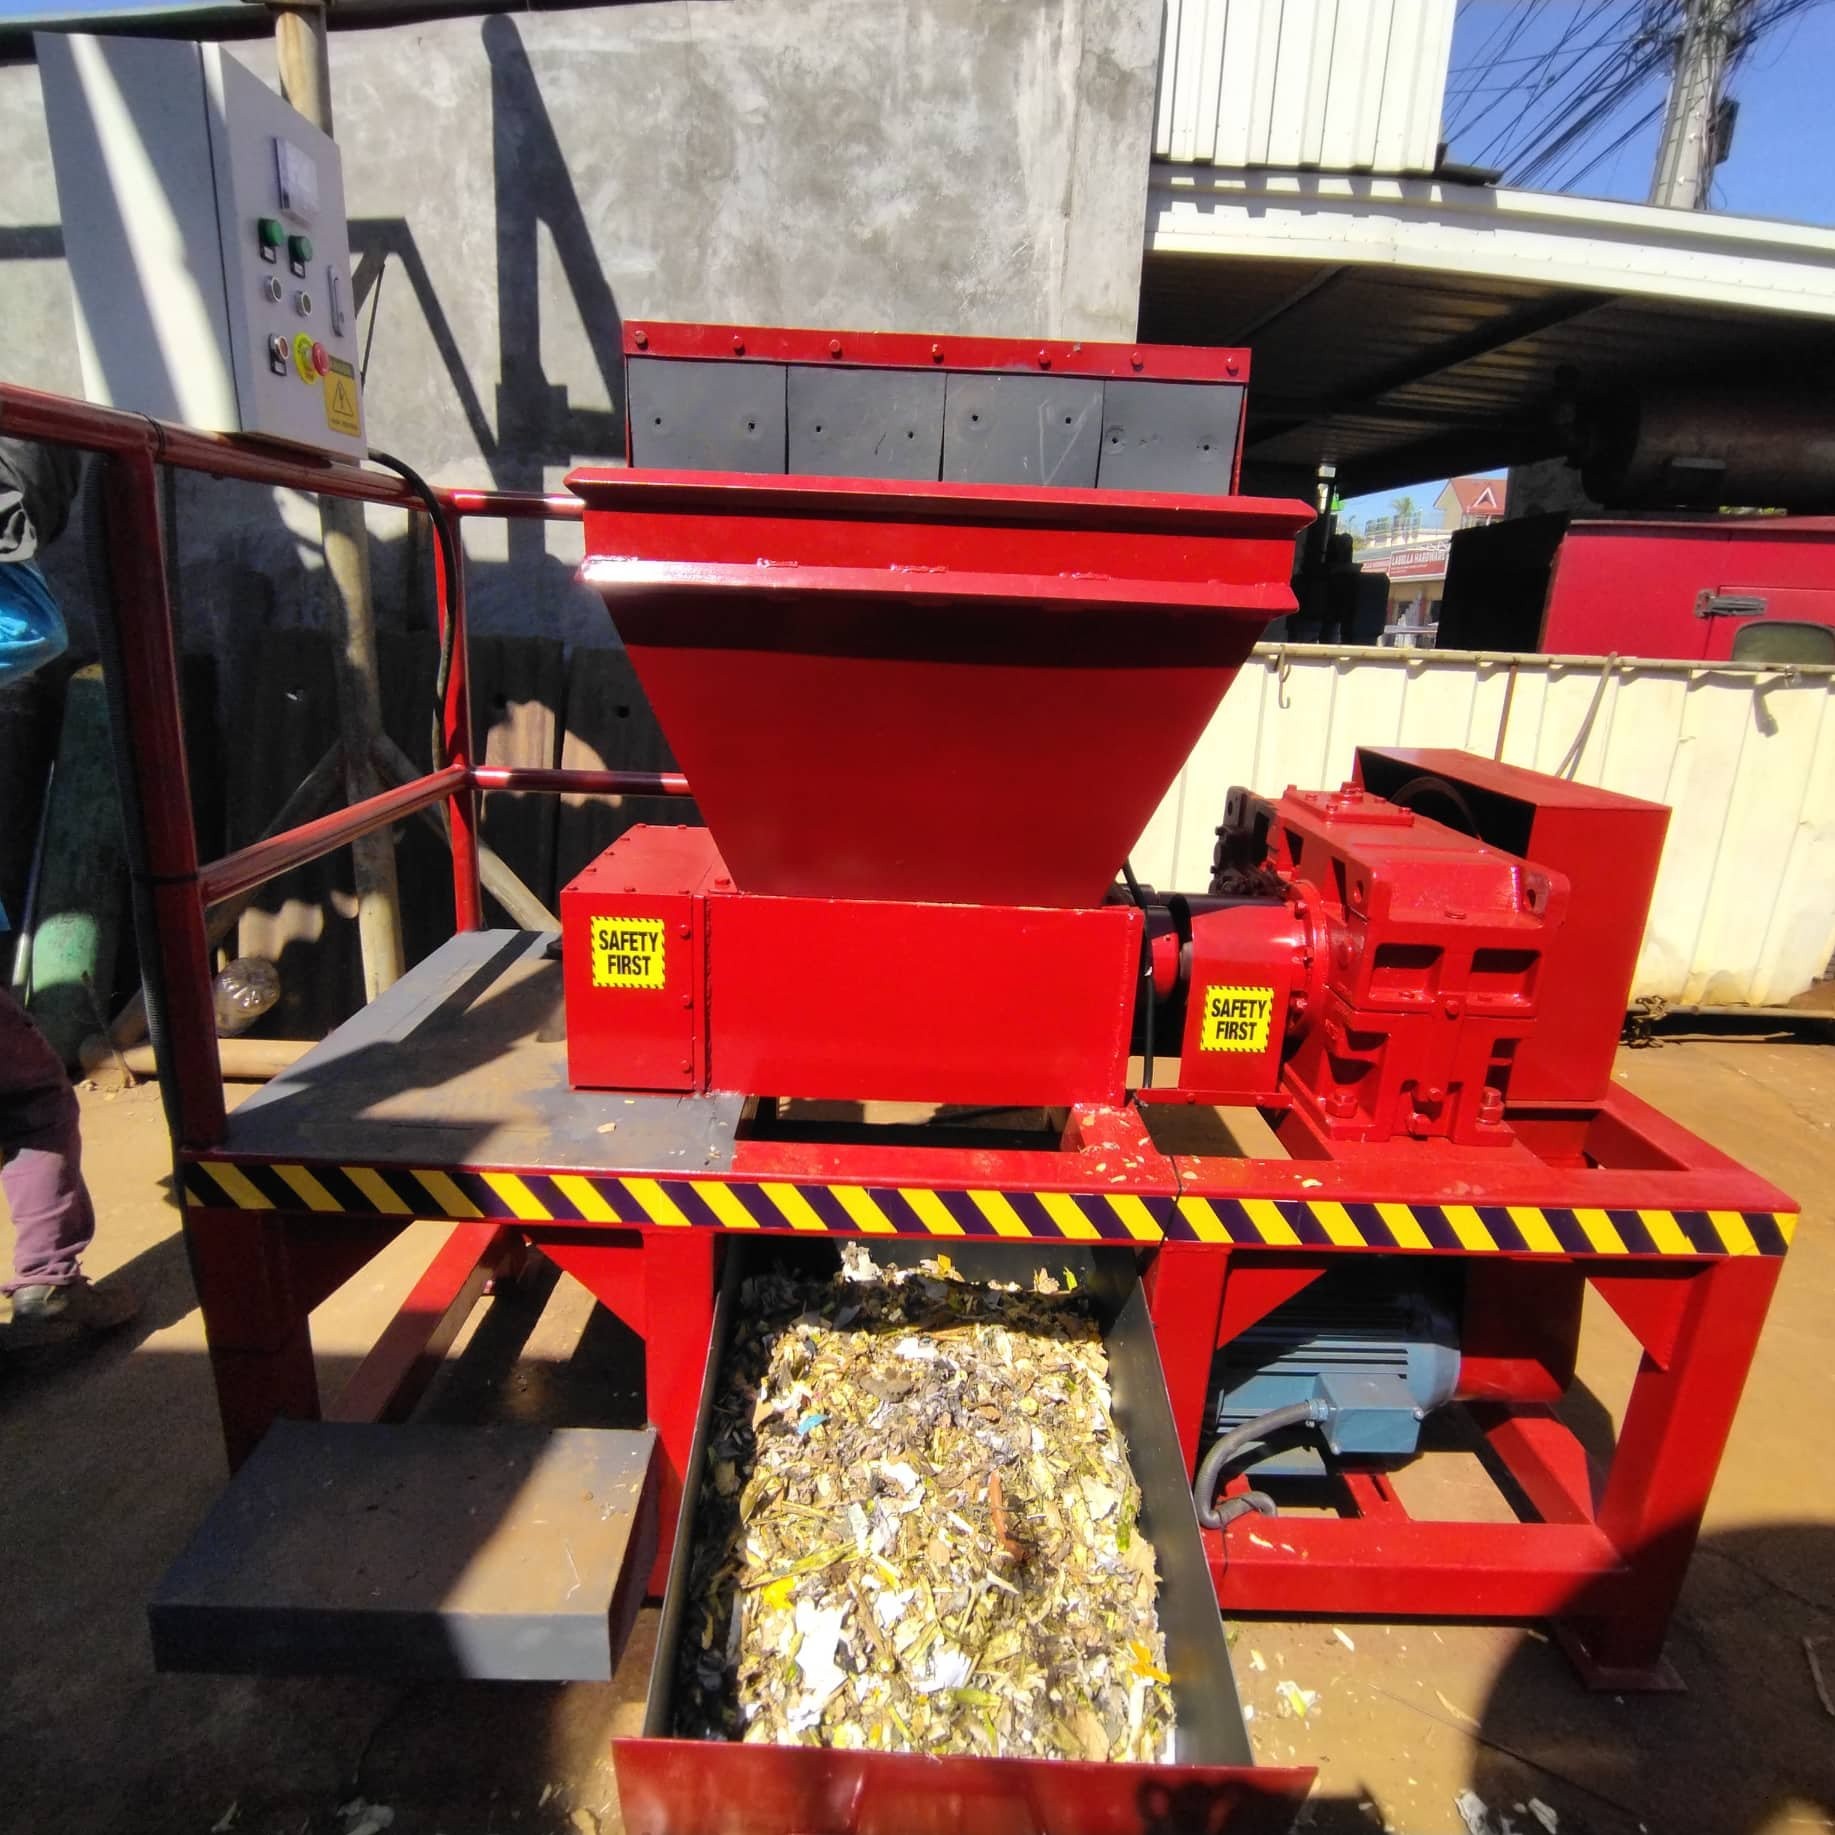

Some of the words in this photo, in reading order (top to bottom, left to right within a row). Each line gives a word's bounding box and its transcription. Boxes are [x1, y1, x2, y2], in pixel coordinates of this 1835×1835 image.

[599, 929, 658, 952] SAFETY
[608, 954, 651, 976] FIRST
[1211, 998, 1267, 1019] SAFETY
[1215, 1021, 1257, 1040] FIRST
